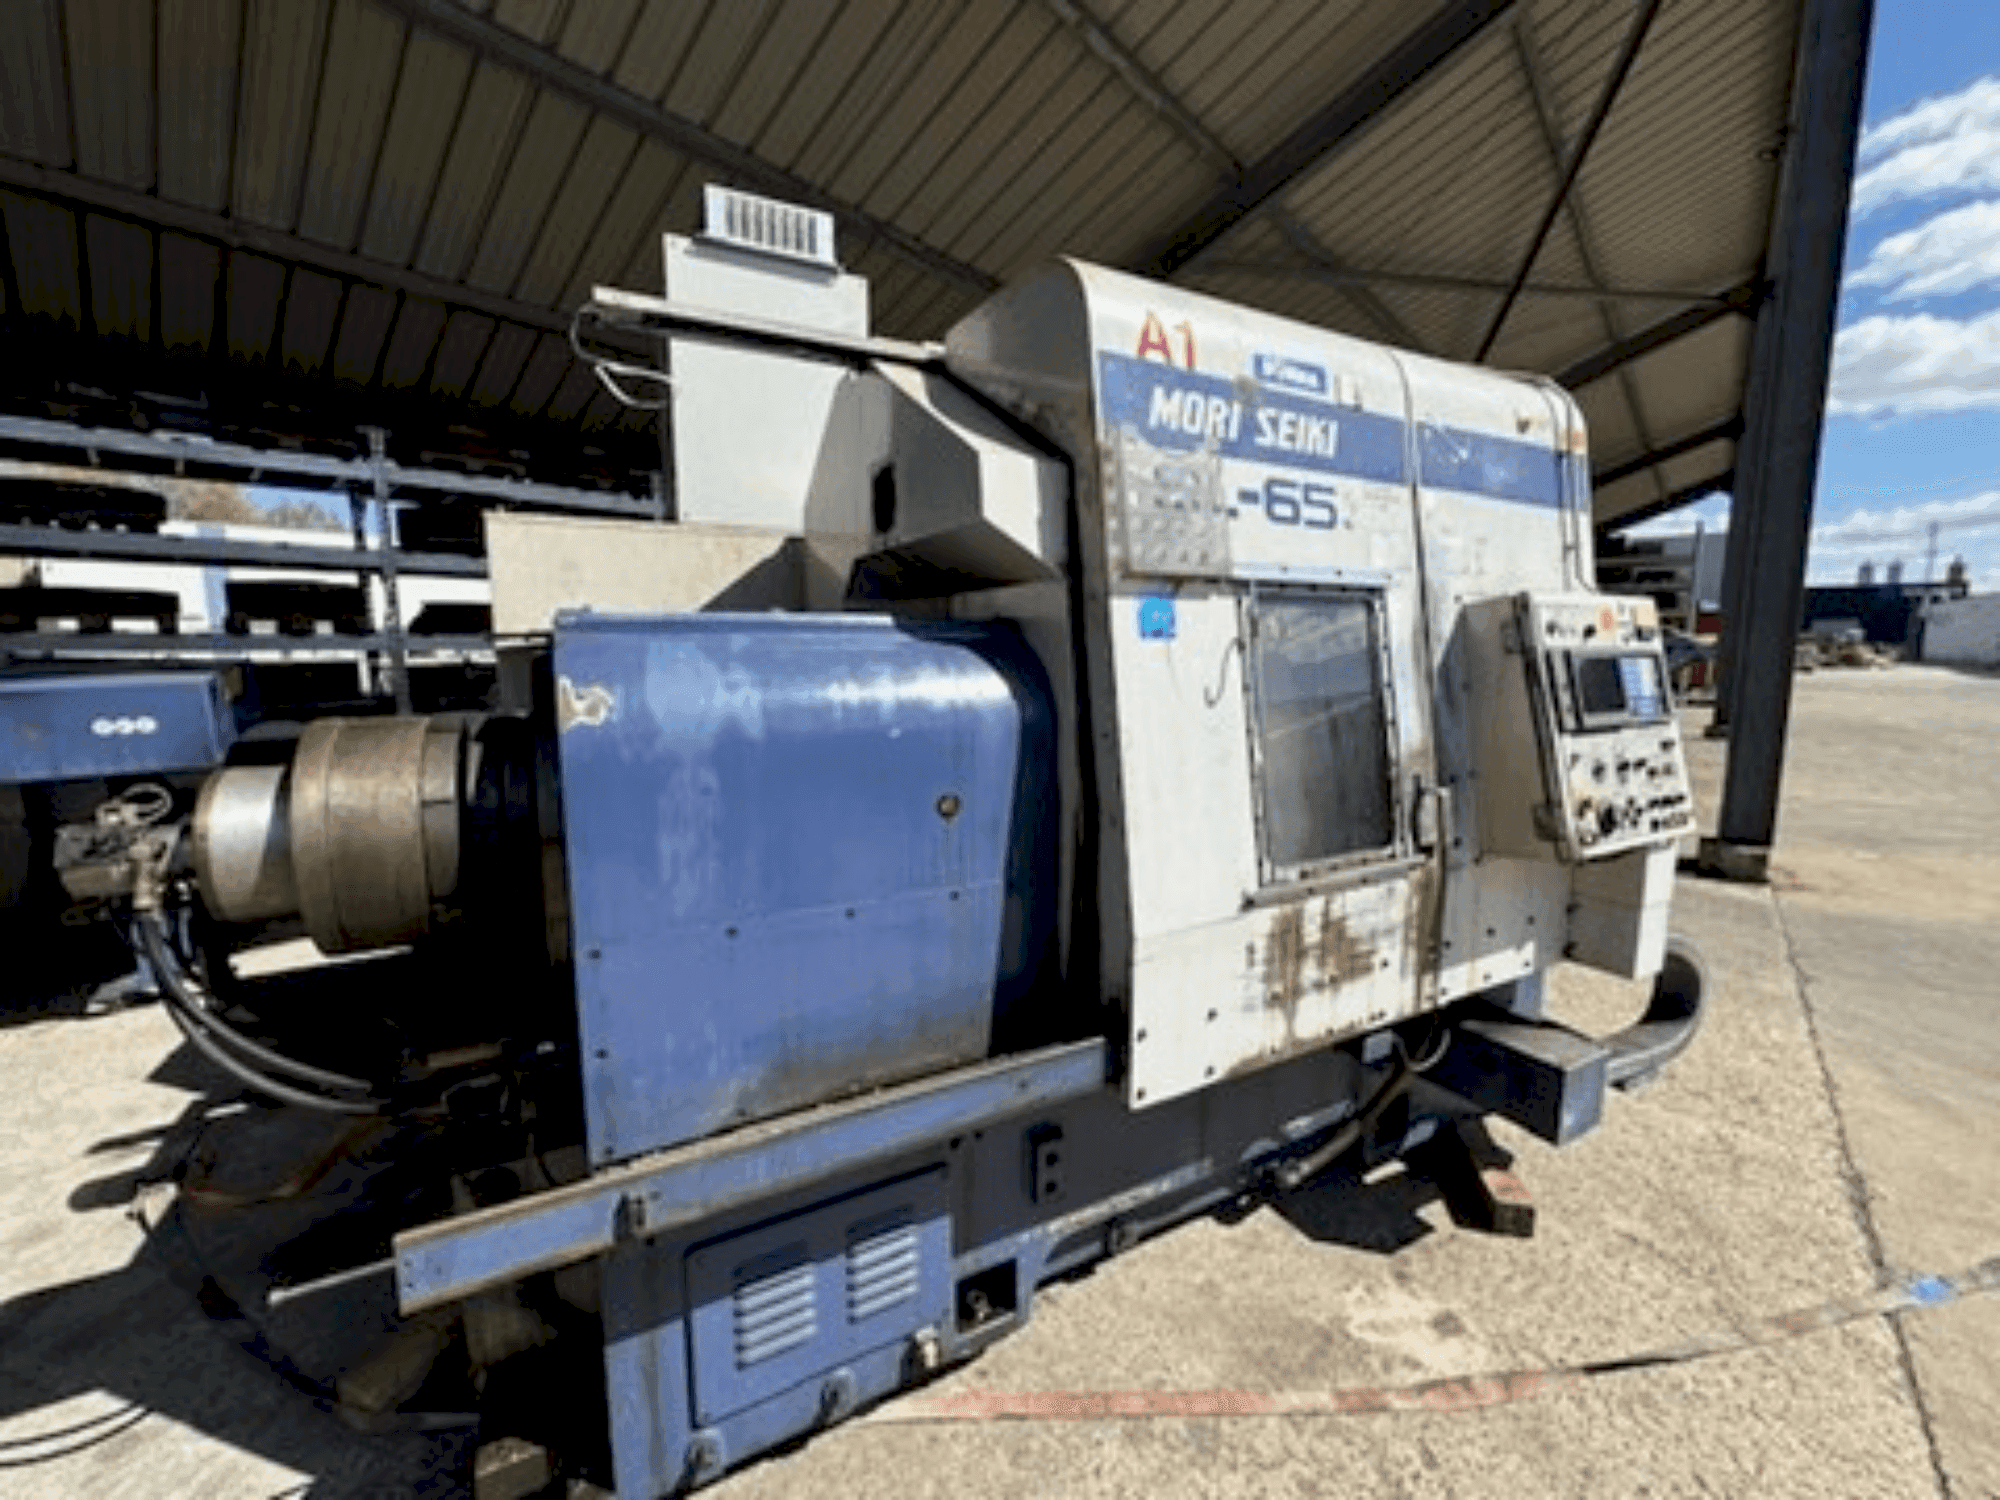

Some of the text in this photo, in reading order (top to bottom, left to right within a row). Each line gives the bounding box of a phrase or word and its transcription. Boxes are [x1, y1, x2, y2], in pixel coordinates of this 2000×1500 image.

[1136, 310, 1198, 371] A1
[1148, 384, 1338, 458] MORI SEIKI
